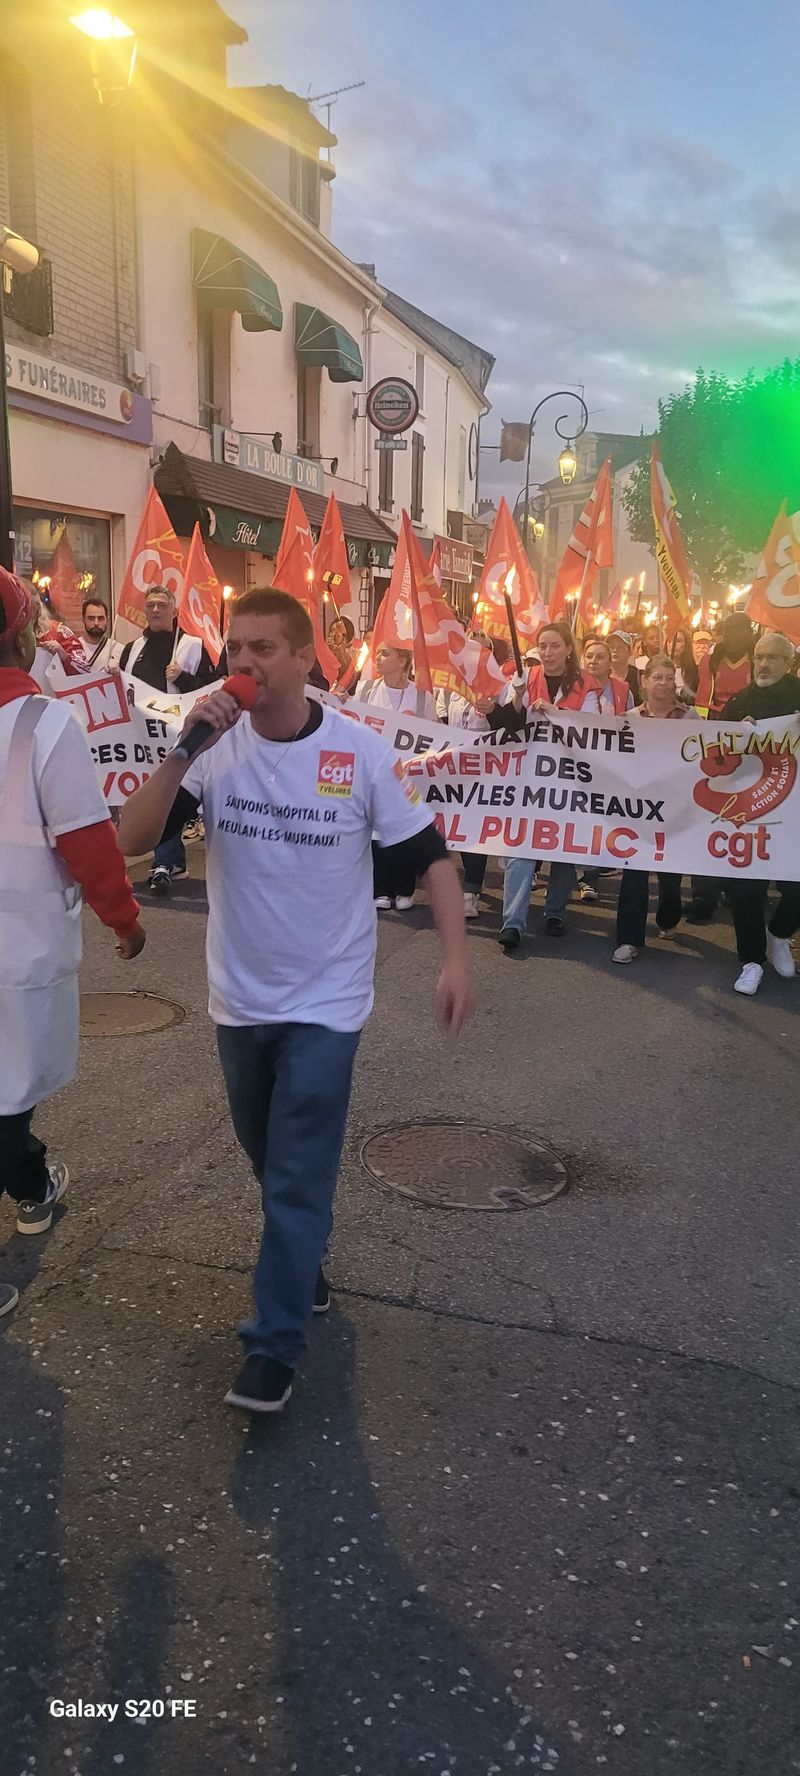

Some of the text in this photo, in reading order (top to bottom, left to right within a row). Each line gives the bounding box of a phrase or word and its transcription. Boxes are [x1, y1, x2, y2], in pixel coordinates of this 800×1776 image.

[18, 358, 107, 409] FUNÉRAIRES
[374, 400, 410, 410] Heineken
[247, 443, 259, 469] LA
[264, 449, 293, 480] BOULE
[297, 461, 318, 488] D'OR
[145, 719, 168, 738] ET
[535, 755, 593, 783] DES
[394, 729, 433, 755] DE
[474, 721, 636, 754] MATERNITÉ
[134, 743, 154, 764] DE
[522, 785, 665, 822] MUREAUX
[320, 763, 353, 784] cgt
[752, 776, 775, 799] SANTÉ
[225, 795, 269, 816] SAUVONS
[324, 810, 339, 824] DE
[750, 790, 779, 812] ACTION
[479, 816, 639, 859] PUBLIC
[654, 832, 666, 861] !
[708, 825, 771, 868] cgt
